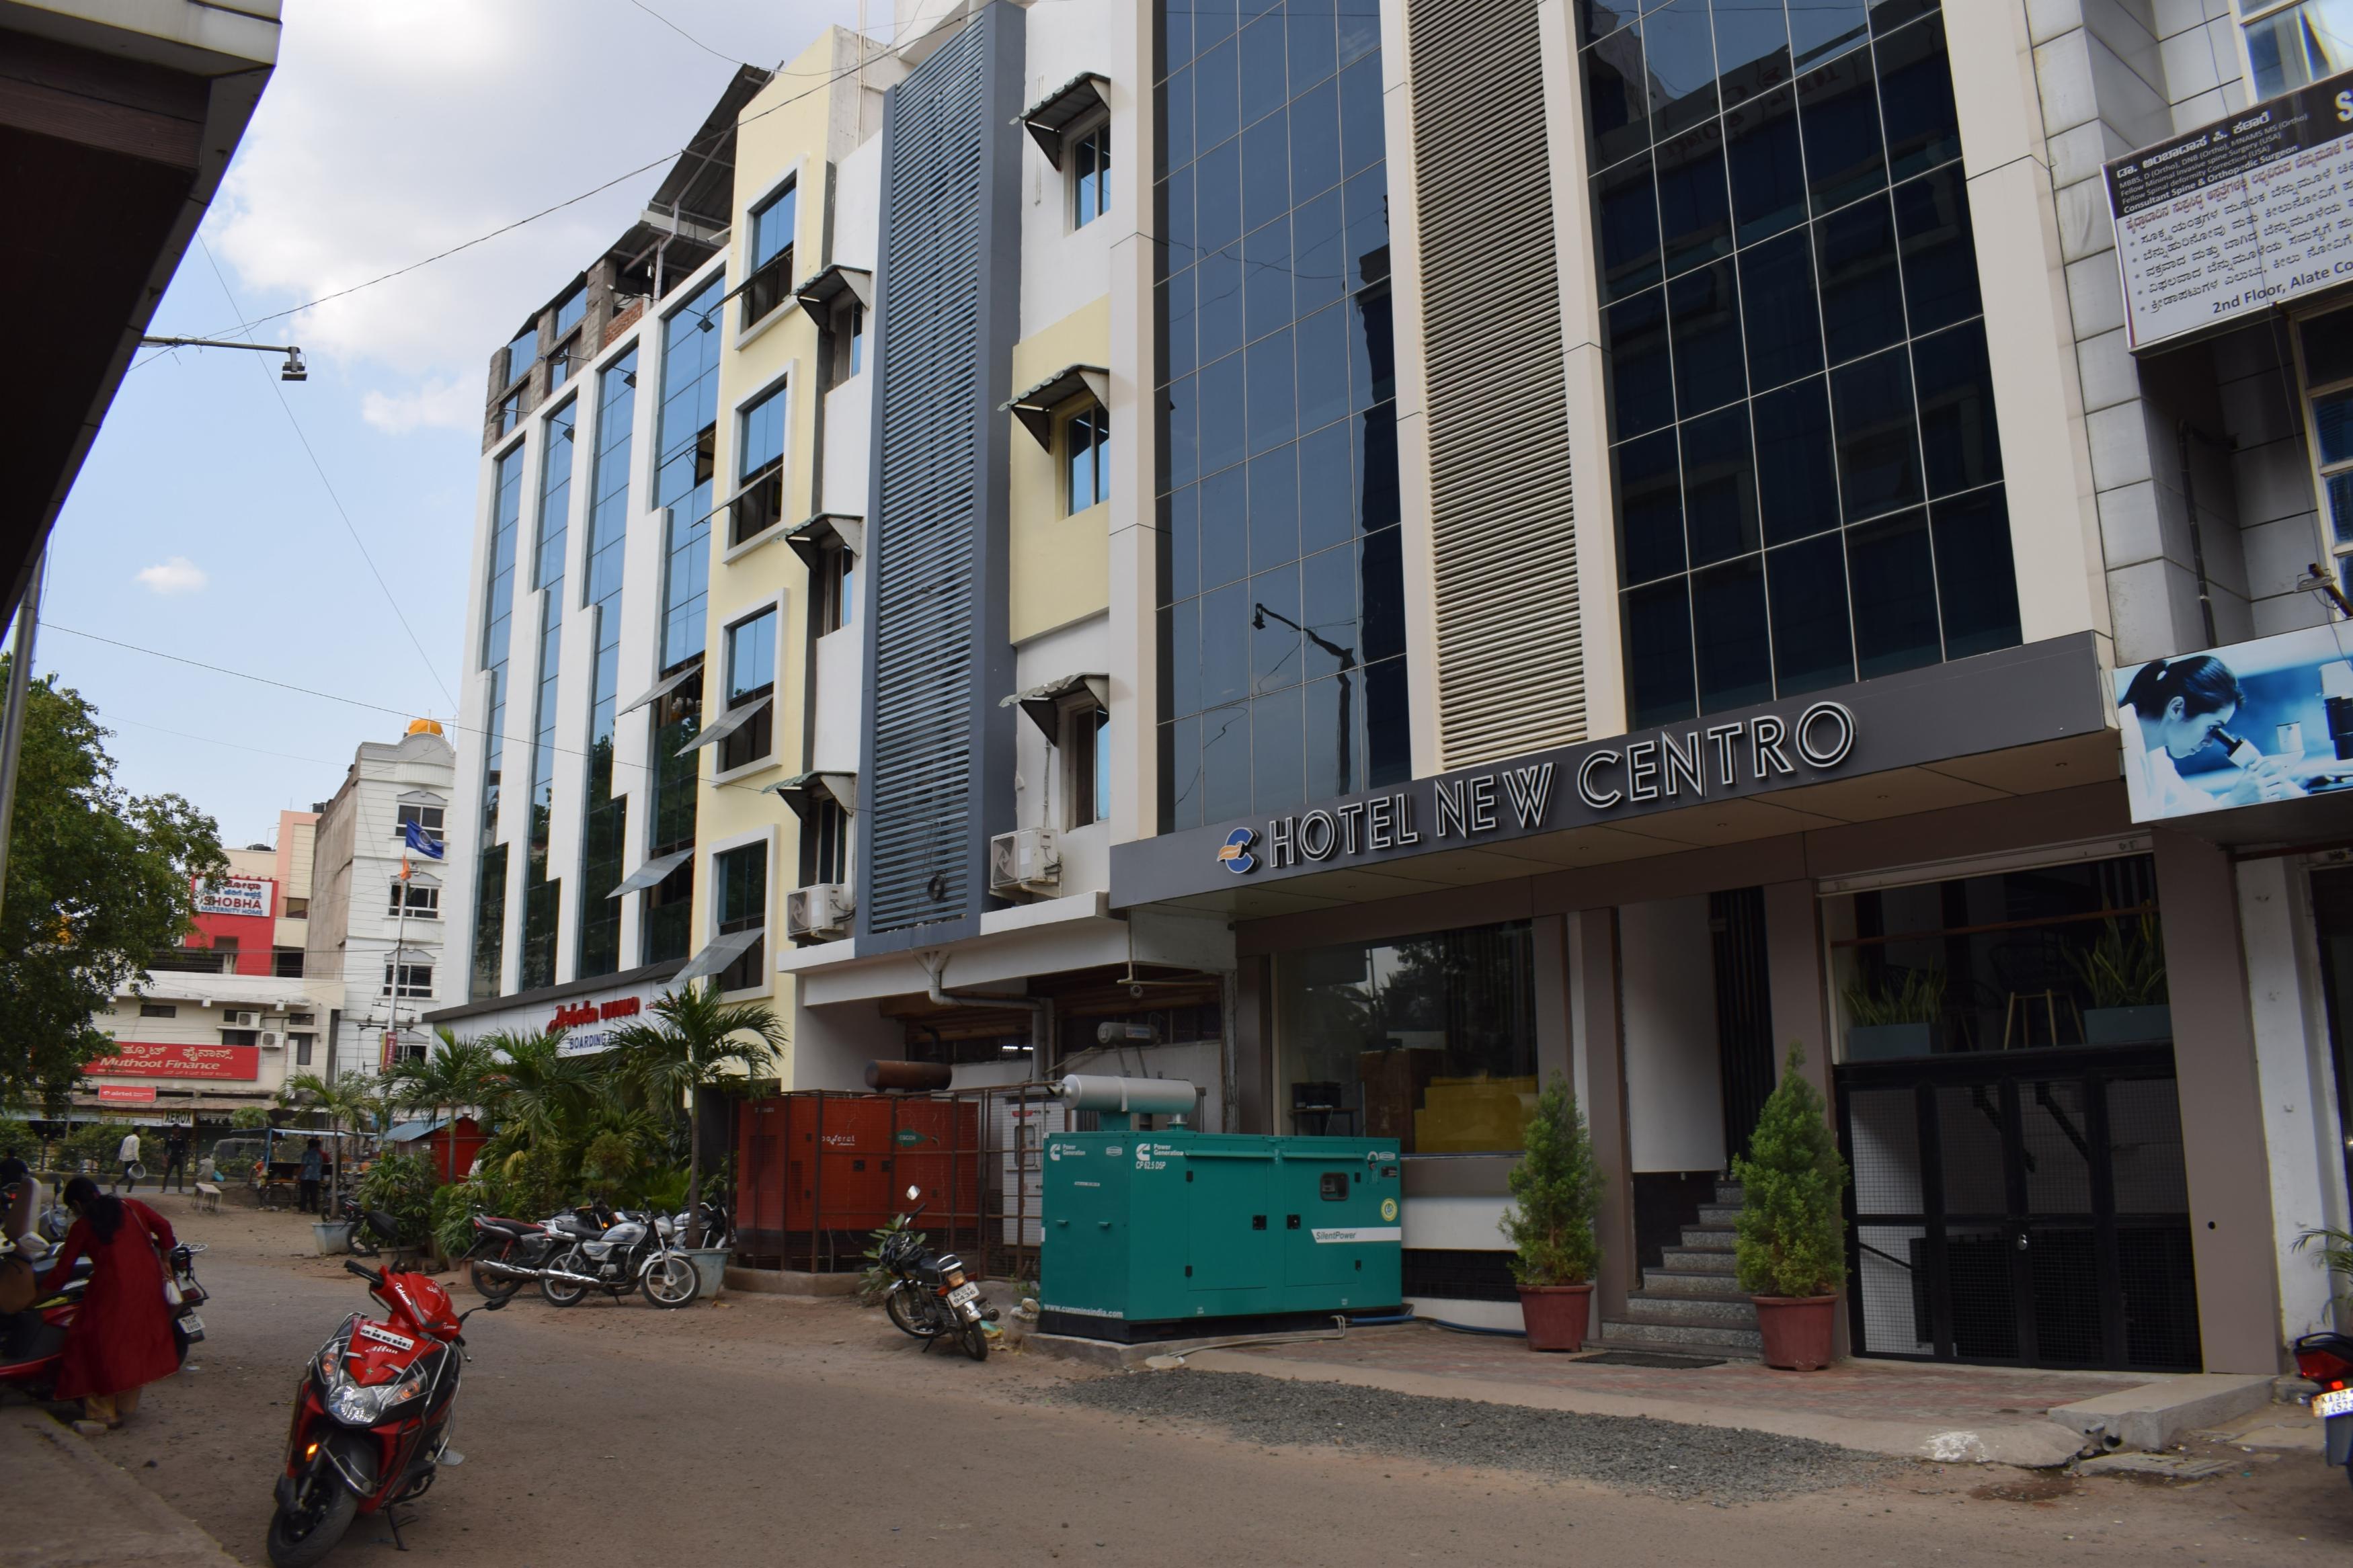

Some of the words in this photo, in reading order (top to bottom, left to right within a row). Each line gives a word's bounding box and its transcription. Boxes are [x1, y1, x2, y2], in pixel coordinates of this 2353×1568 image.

[2118, 175, 2142, 189] MBBS,
[2151, 161, 2180, 177] (Ortho),
[2181, 154, 2198, 165] DNB
[2199, 143, 2229, 159] (Ortho),
[2230, 130, 2263, 147] MNAMS
[2264, 124, 2278, 134] MS
[2278, 114, 2307, 130] (Ortho)
[2120, 184, 2144, 197] Fellow
[2145, 171, 2176, 188] Minimal
[2176, 161, 2206, 175] Invasive
[2206, 153, 2227, 165] spine
[2228, 141, 2258, 157] Surgery
[2258, 131, 2281, 146] (USA)
[2121, 192, 2145, 205] Fellow
[2146, 181, 2169, 196] Spinal
[2169, 169, 2206, 187] deformity
[2206, 154, 2247, 173] Correction
[2247, 144, 2270, 159] (USA)
[2123, 191, 2169, 213] Consultant
[2171, 182, 2196, 196] Spine
[2197, 177, 2205, 186] &
[2206, 159, 2258, 182] Orthopedic
[2259, 145, 2297, 163] Surgeon
[2211, 294, 2241, 314] 2nd
[2243, 283, 2286, 304] Floor,
[2290, 268, 2330, 290] Alate
[1269, 794, 1420, 868] HOTEL
[1435, 761, 1557, 839] NEW
[1577, 701, 1857, 809] CENTRO
[200, 905, 241, 914] MATERNITY
[203, 896, 262, 909] SHOBHA
[569, 1032, 606, 1050] BOARDING
[99, 1057, 163, 1068] Muthoot
[165, 1060, 221, 1070] Finance
[164, 1110, 192, 1124] XEROX
[1316, 1231, 1356, 1240] SilentPower
[954, 1289, 975, 1303] 9436
[1043, 1303, 1123, 1318] www.cumminsindia.com
